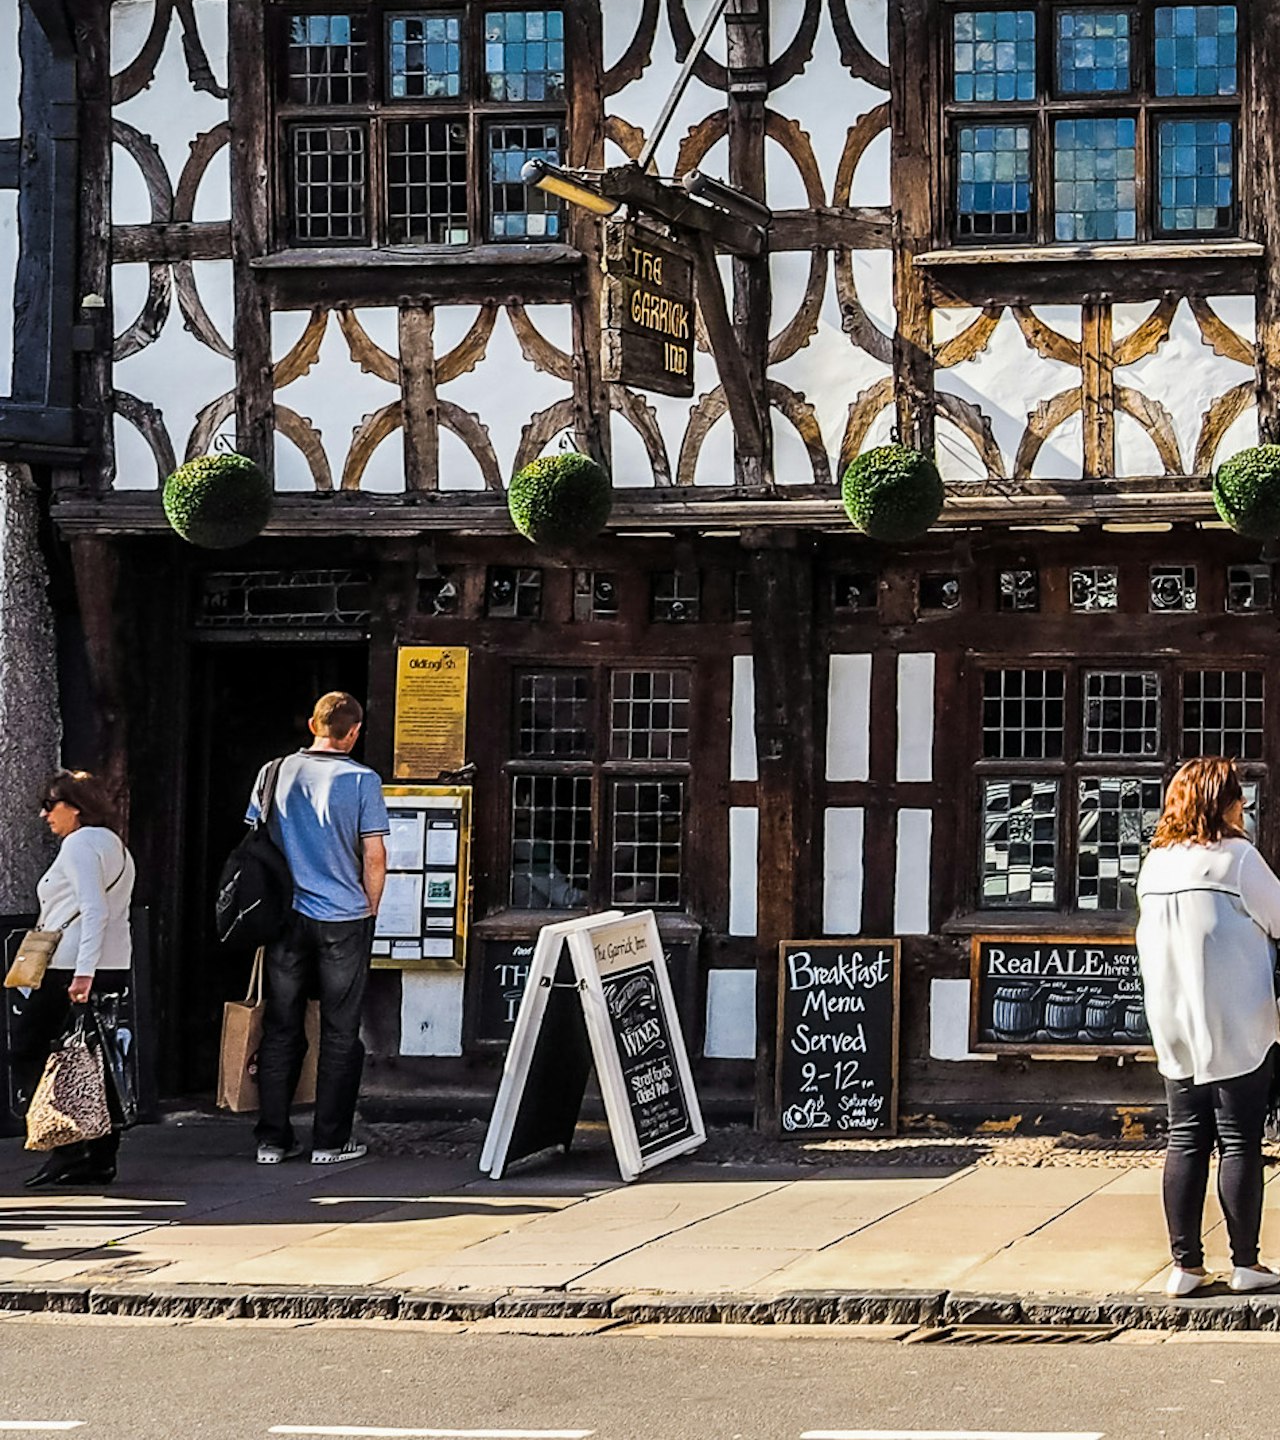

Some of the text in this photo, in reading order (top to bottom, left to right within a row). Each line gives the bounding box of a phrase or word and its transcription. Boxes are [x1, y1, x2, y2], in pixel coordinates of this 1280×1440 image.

[631, 289, 689, 339] GARRICK
[788, 950, 891, 991] Breakfast
[987, 948, 1041, 975] Real
[1041, 949, 1106, 976] ALE
[1103, 962, 1132, 977] here
[1113, 954, 1141, 966] serv
[494, 963, 530, 987] TH
[1118, 978, 1143, 992] Cask
[801, 989, 866, 1021] Menu
[620, 1017, 661, 1058] WINES
[790, 1022, 867, 1055] Served
[838, 1094, 884, 1113] Saturday
